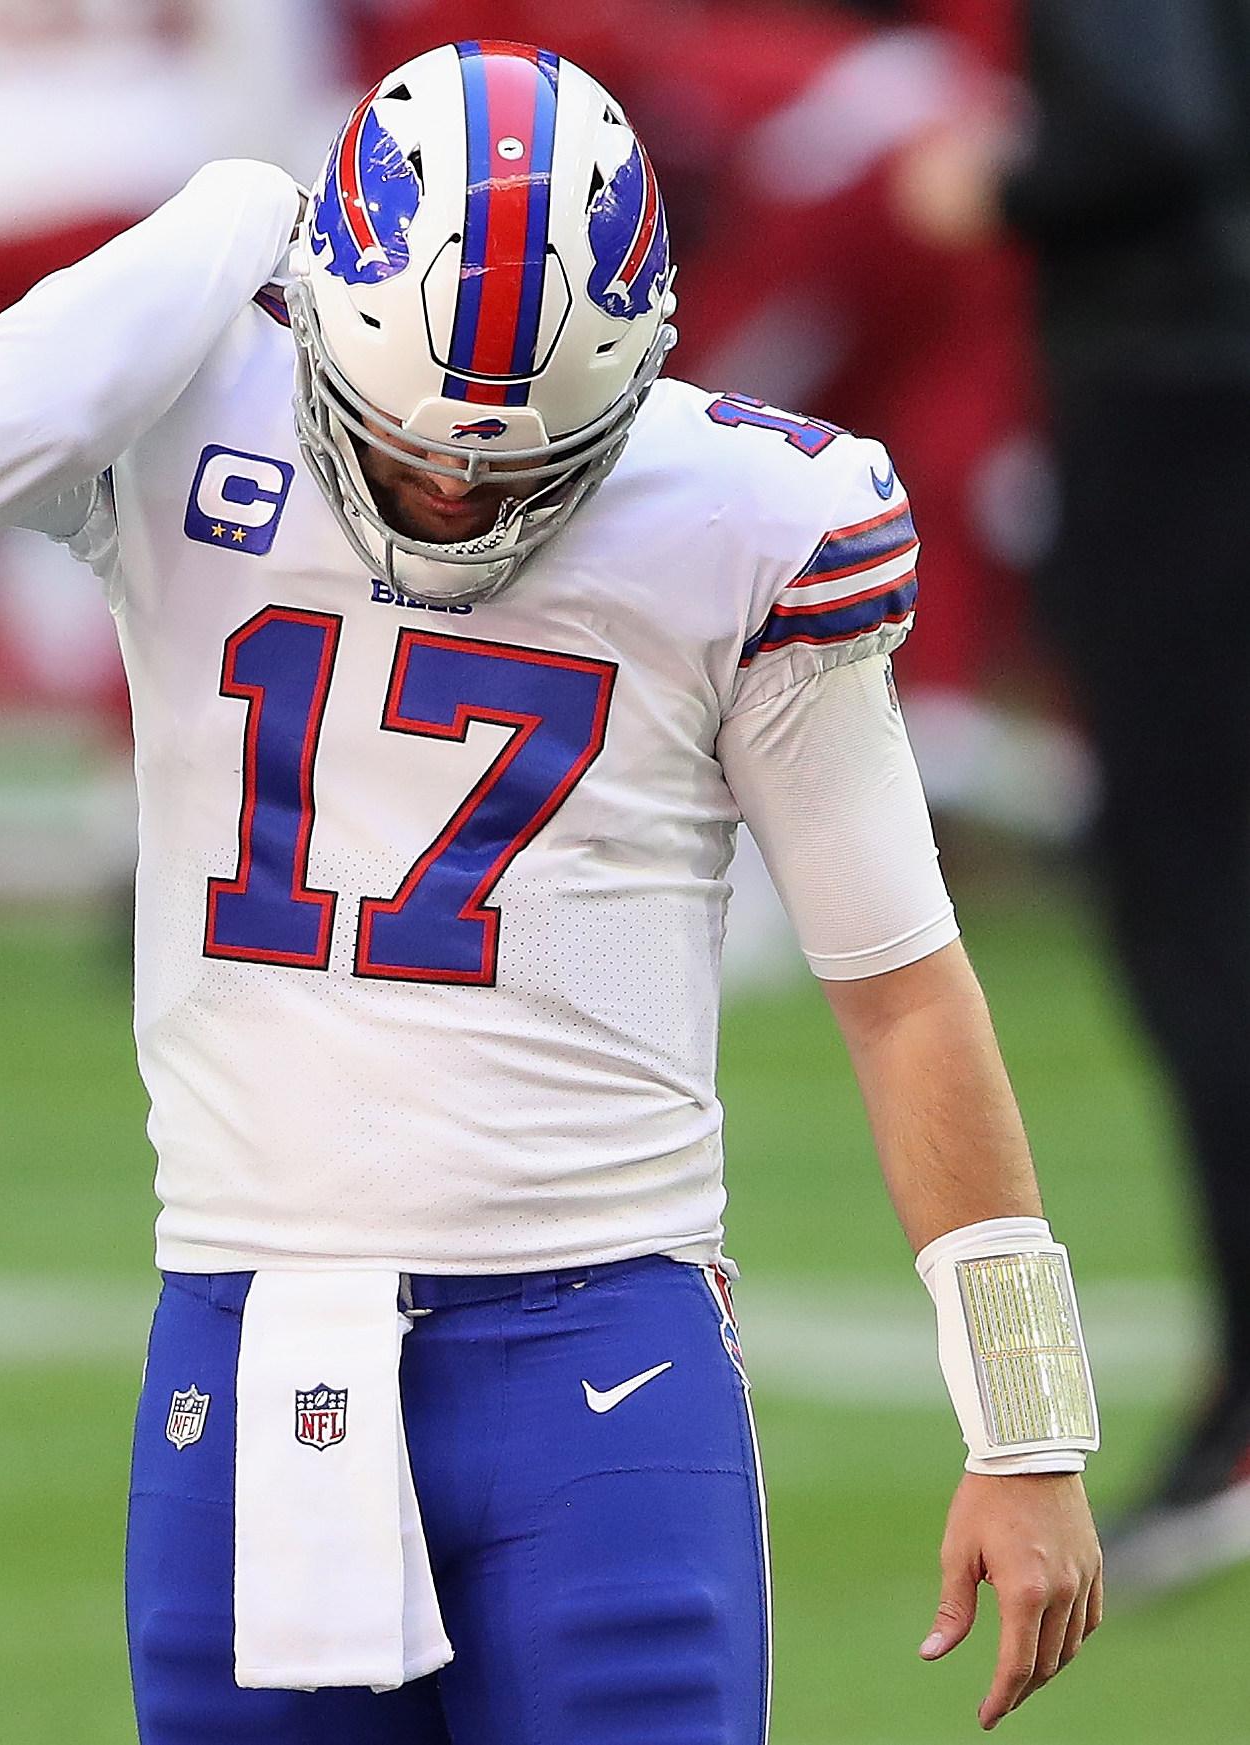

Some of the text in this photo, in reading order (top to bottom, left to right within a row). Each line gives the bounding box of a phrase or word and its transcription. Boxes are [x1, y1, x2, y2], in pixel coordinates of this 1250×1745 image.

[705, 391, 851, 459] 1
[196, 452, 284, 528] C
[202, 604, 619, 988] 17
[171, 1414, 196, 1438] NFL
[298, 1411, 343, 1443] NFL
